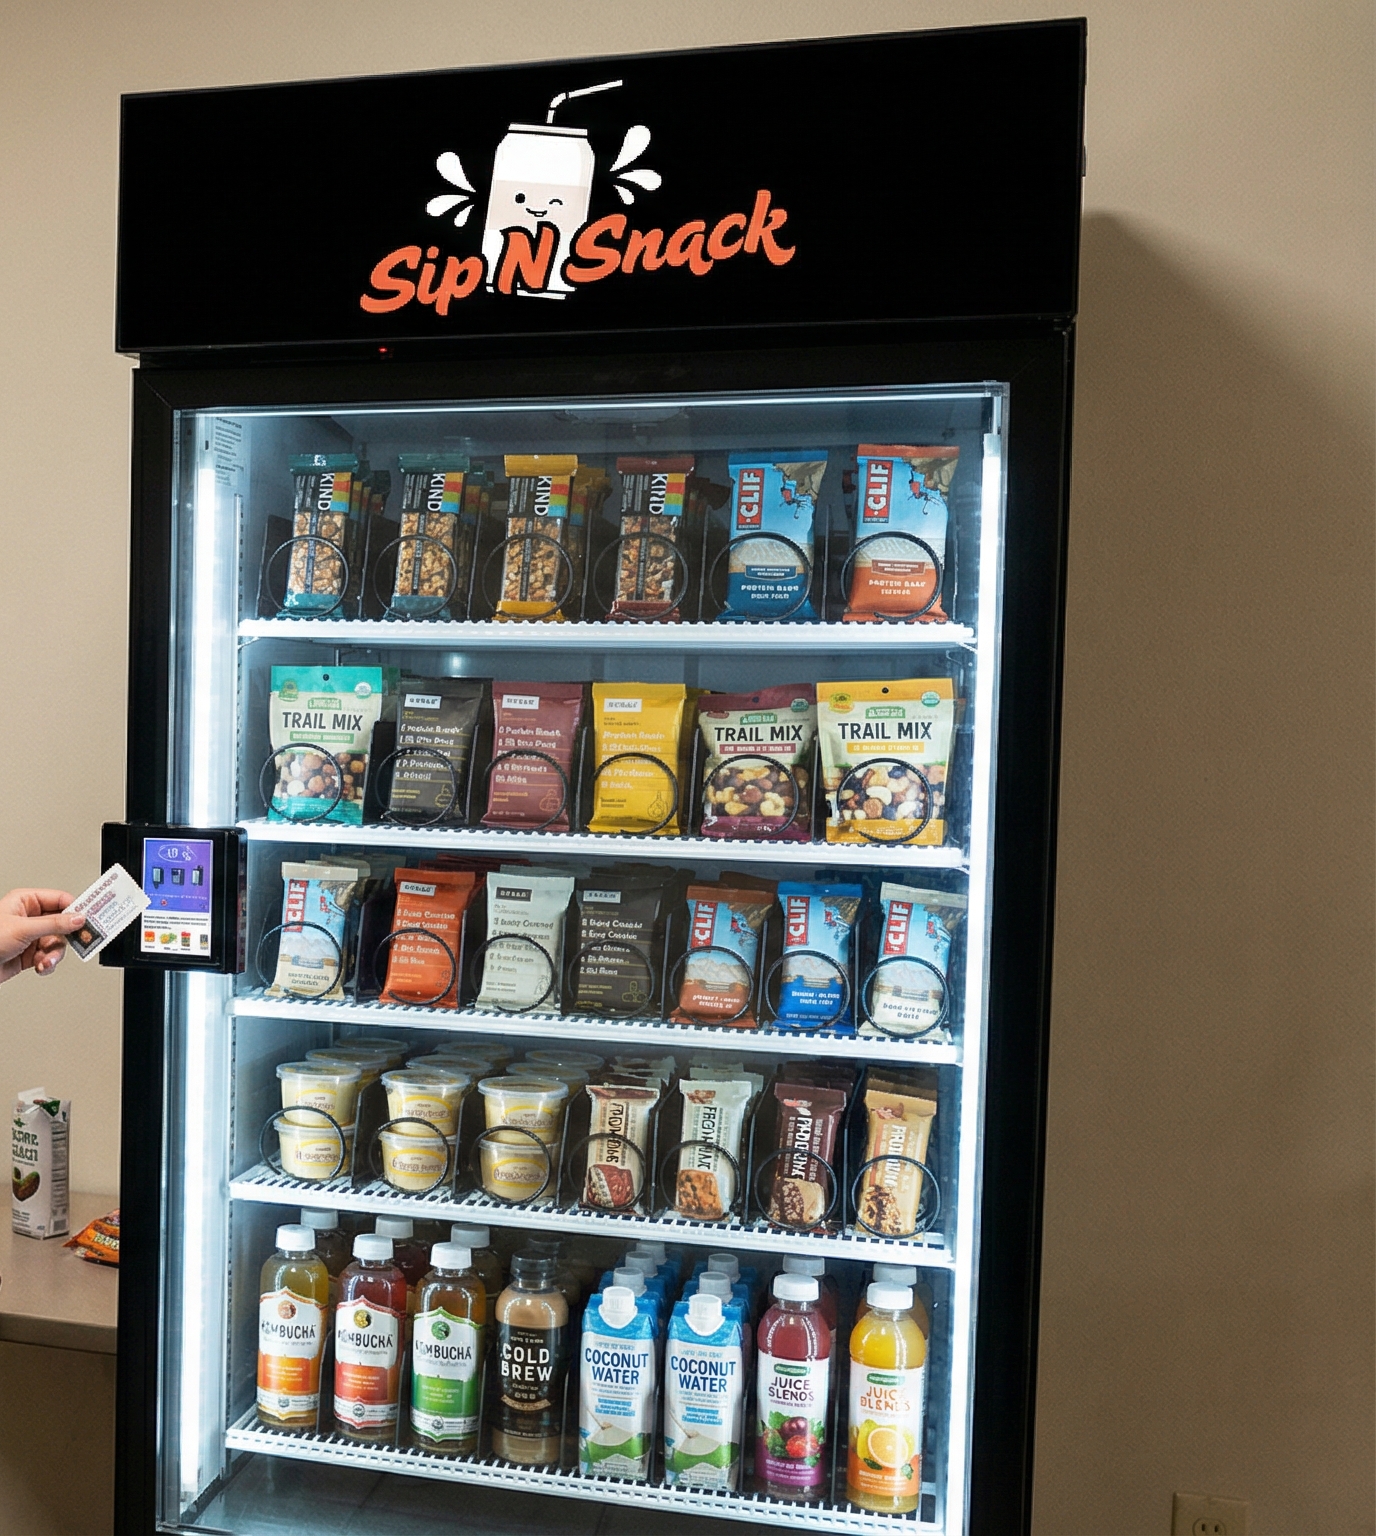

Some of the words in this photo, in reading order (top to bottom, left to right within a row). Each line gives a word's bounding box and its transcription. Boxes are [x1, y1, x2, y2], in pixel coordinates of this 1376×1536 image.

[360, 245, 483, 316] Sip
[498, 225, 554, 295] N
[565, 190, 795, 283] Snack
[317, 473, 335, 511] KIND
[427, 473, 446, 512] KIND
[534, 476, 552, 516] KIND
[649, 473, 668, 515] KIND
[740, 471, 761, 518] CLIF
[867, 464, 889, 511] CLIF
[282, 712, 326, 730] TRAIL
[332, 713, 363, 731] MIX
[838, 722, 891, 740] TRAIL
[898, 722, 932, 740] MIX
[714, 727, 763, 742] TRAIL
[770, 725, 803, 741] MIX
[287, 882, 306, 922] CLIF
[695, 902, 715, 941] CLIF
[788, 898, 808, 936] CLIF
[888, 903, 909, 944] CLIF
[261, 1320, 316, 1340] MBUCHA
[337, 1329, 394, 1349] MBUCHA
[415, 1340, 472, 1361] KMBUCHA
[502, 1343, 550, 1365] COLD
[585, 1348, 649, 1369] COCONUT
[501, 1360, 552, 1382] BREW
[592, 1365, 639, 1385] WATER
[671, 1356, 736, 1377] COCONUT
[678, 1373, 727, 1393] WATER
[771, 1375, 811, 1390] JUICE
[866, 1386, 905, 1401] JUIC
